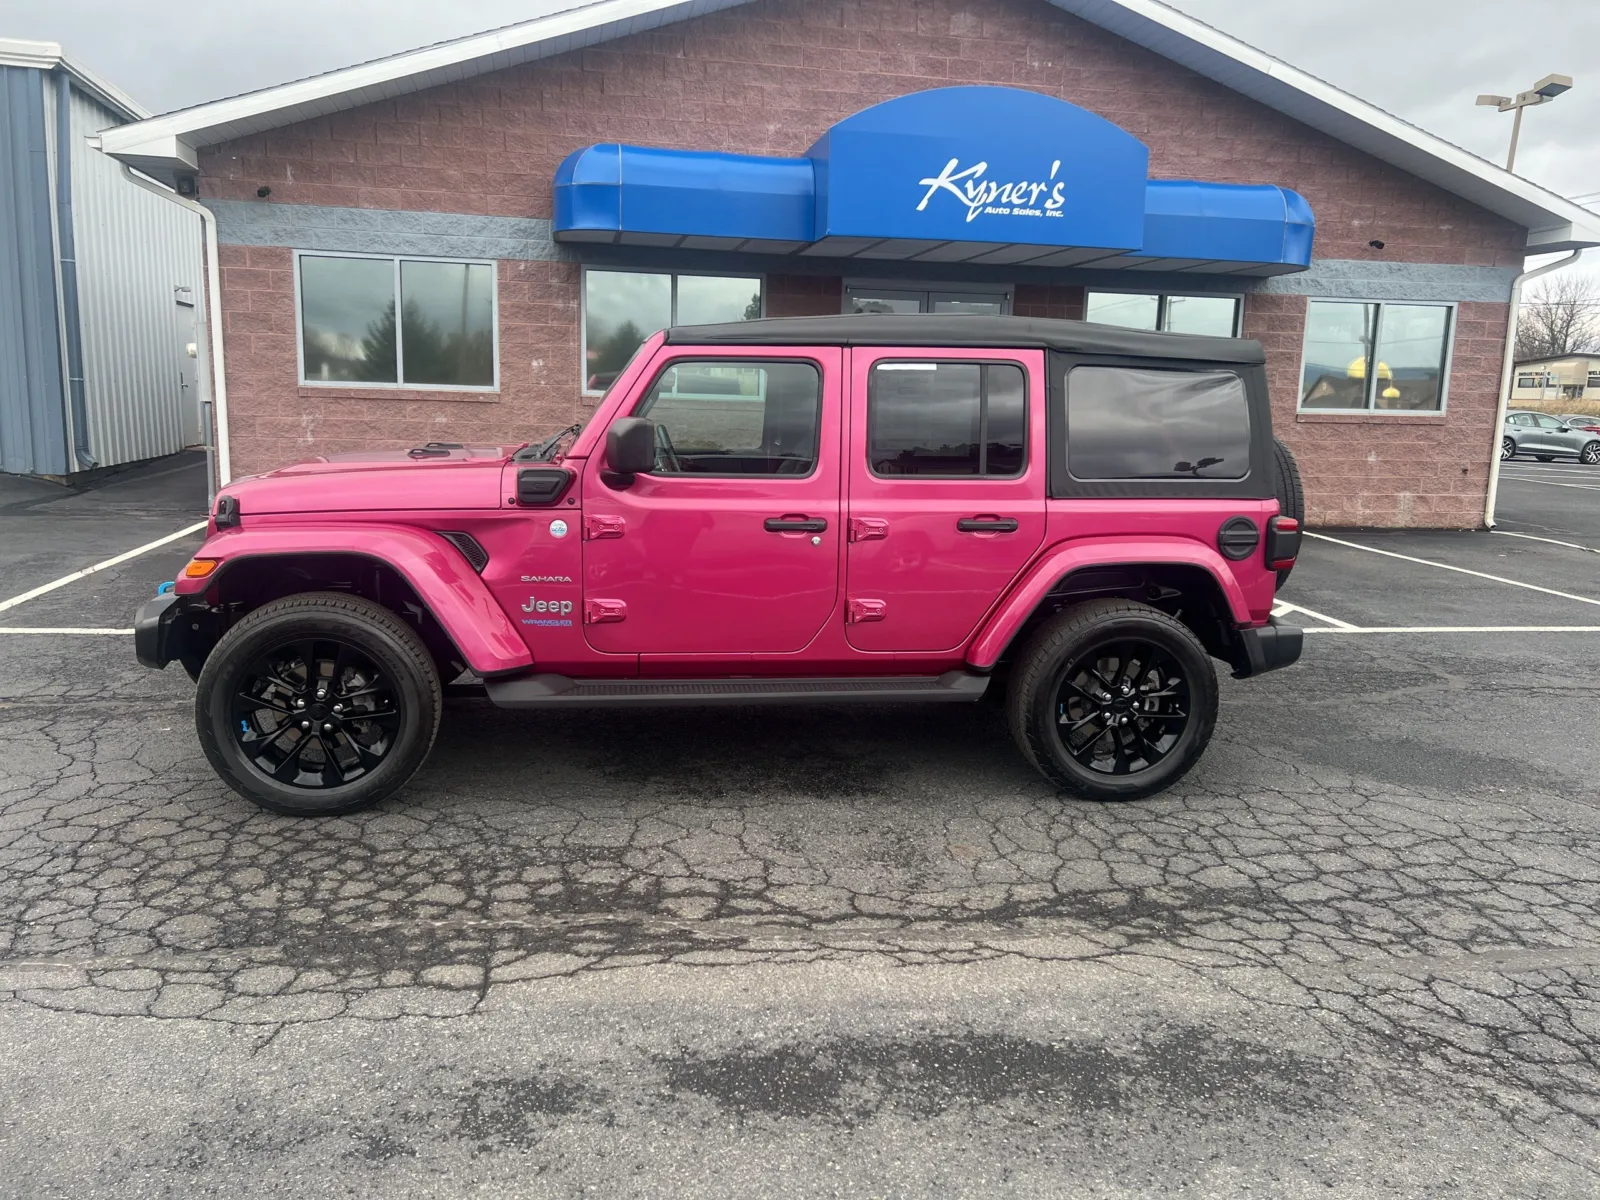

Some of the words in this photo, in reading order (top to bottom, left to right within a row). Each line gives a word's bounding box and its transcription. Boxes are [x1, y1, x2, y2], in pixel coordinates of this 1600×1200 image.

[916, 157, 1065, 223] Kyner's
[984, 206, 1010, 215] Auto
[1012, 207, 1043, 217] Sales,
[1045, 209, 1064, 217] Inc.
[521, 596, 573, 616] Jeep
